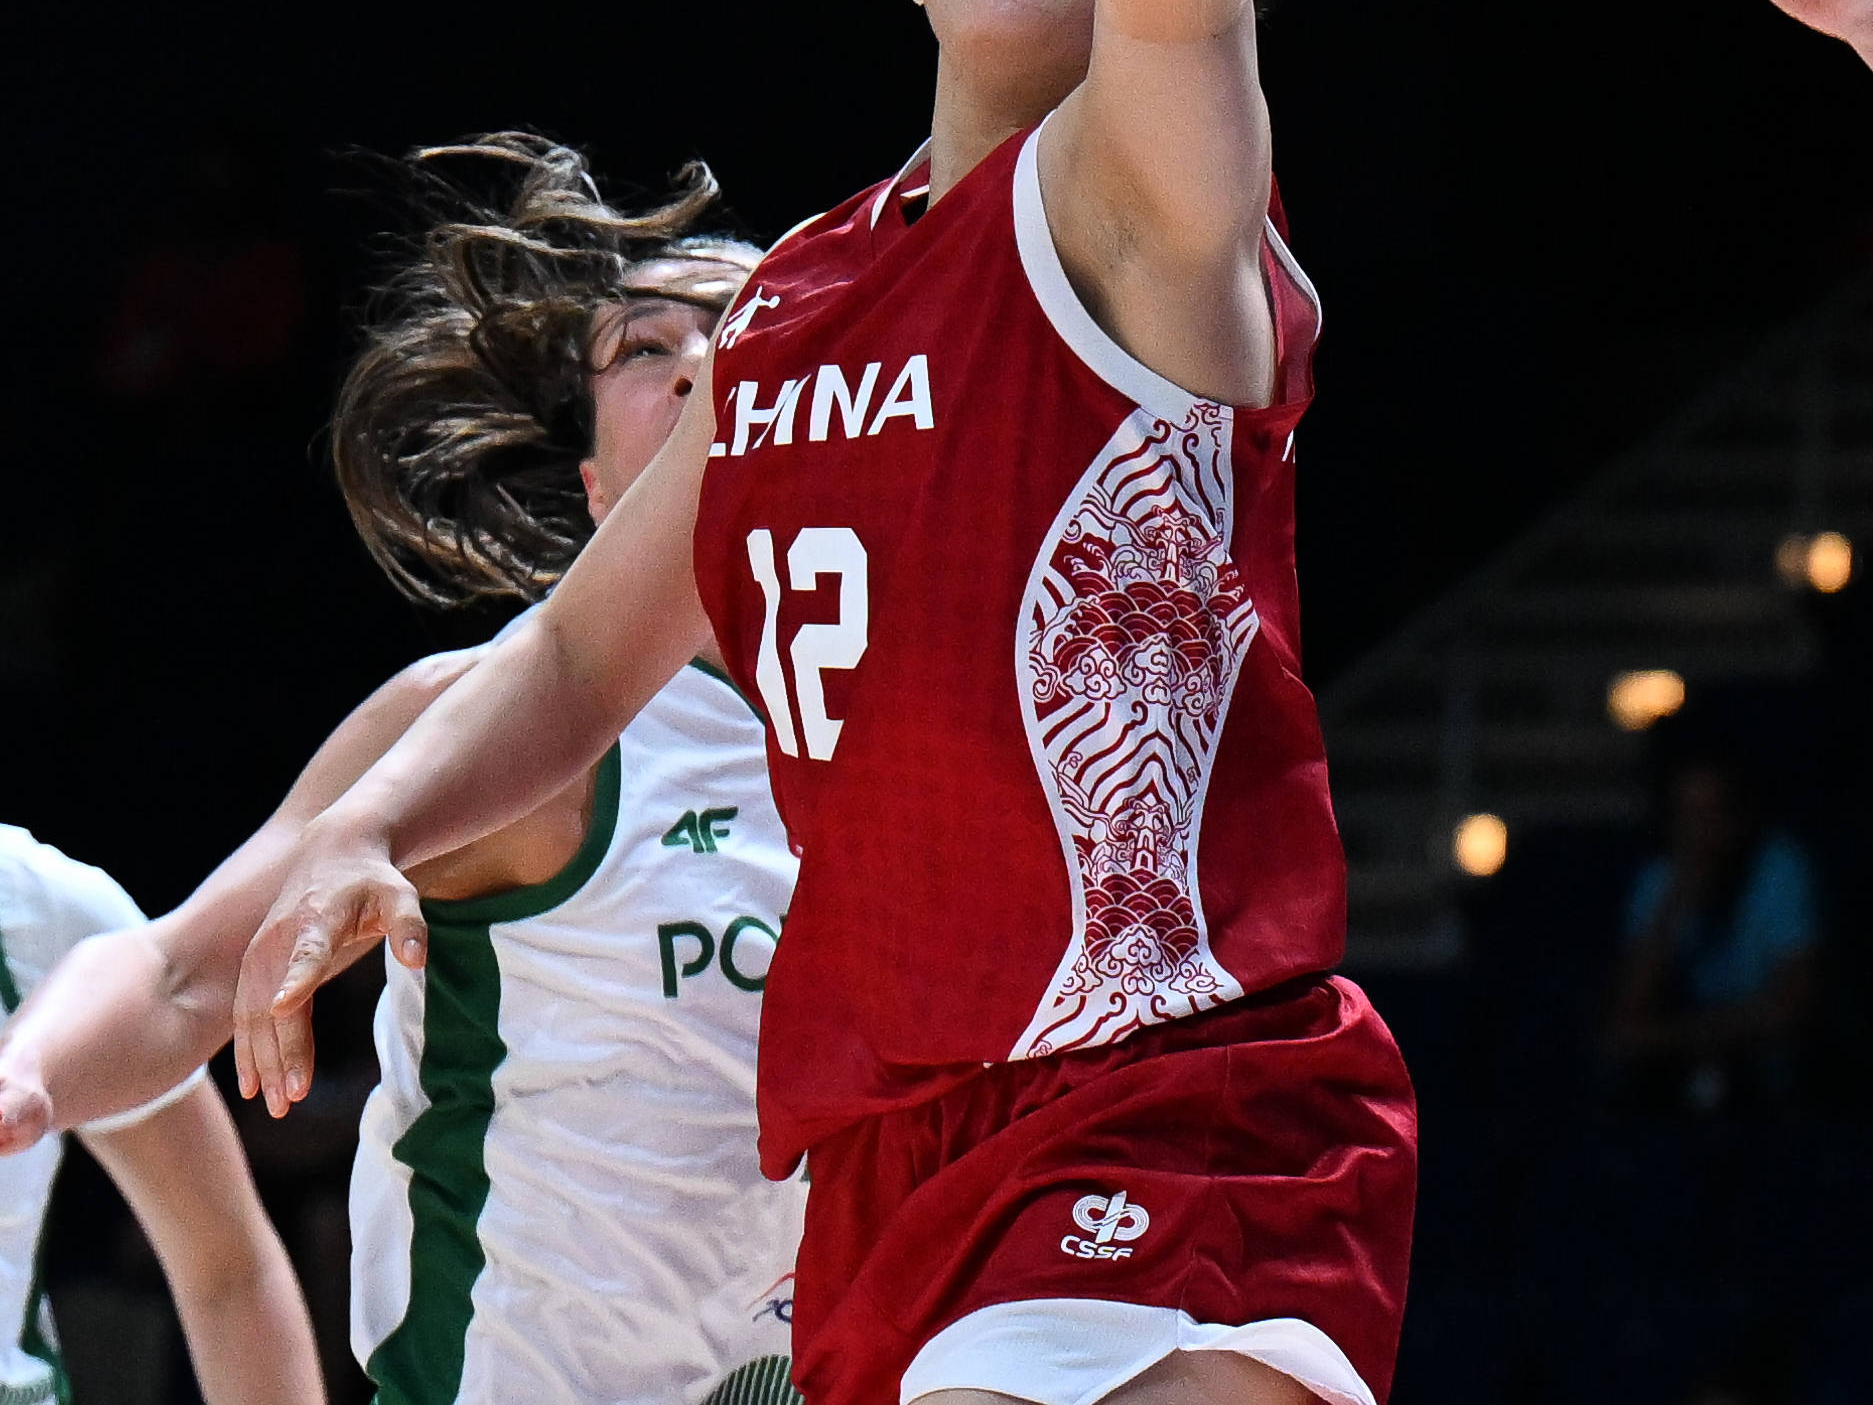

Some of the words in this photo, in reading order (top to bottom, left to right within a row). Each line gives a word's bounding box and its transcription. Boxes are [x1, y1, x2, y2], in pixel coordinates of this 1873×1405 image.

[708, 354, 935, 457] HINA
[746, 527, 869, 761] 12
[661, 805, 739, 854] 4F
[658, 914, 788, 999] PO
[1060, 1235, 1134, 1262] CSSF
